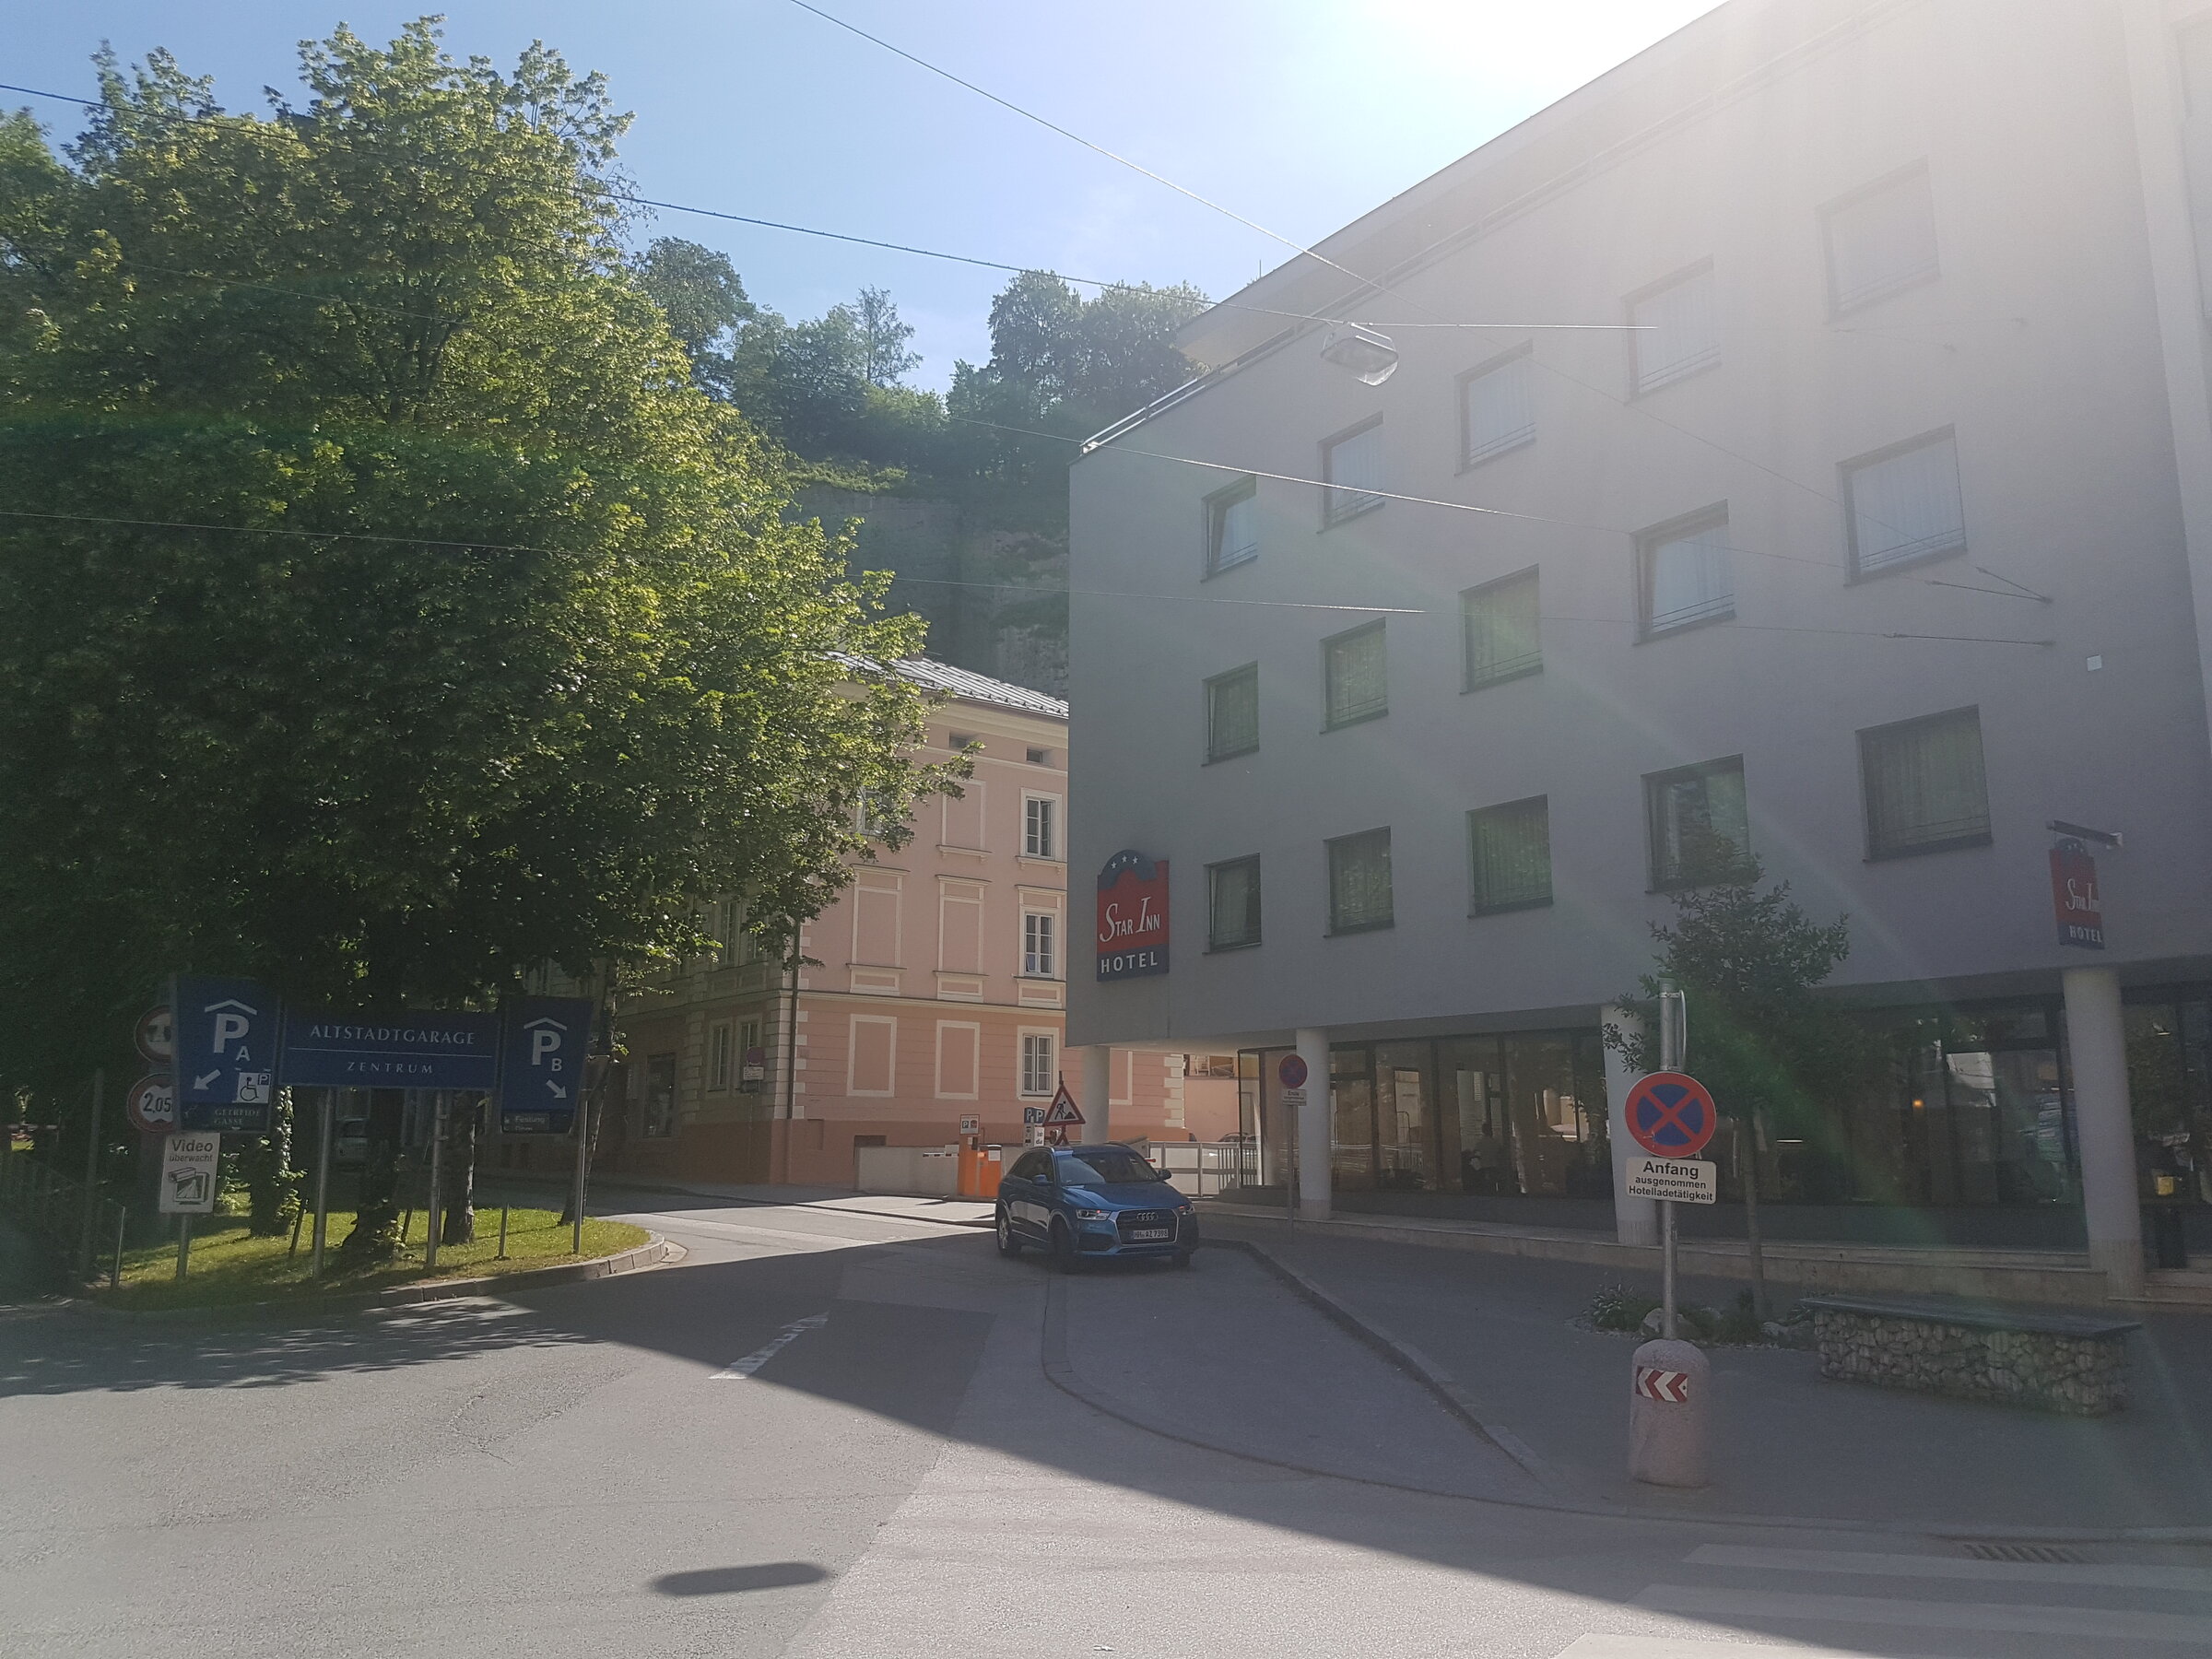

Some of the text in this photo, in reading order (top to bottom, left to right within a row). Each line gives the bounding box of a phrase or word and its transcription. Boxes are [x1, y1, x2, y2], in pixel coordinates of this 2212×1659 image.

[2068, 925, 2102, 943] HOTEL
[1100, 951, 1158, 974] HOTEL
[213, 1013, 250, 1053] P
[310, 1024, 476, 1045] ALTSTADTGARAGE
[235, 1045, 251, 1061] A
[532, 1030, 561, 1065] P
[347, 1061, 433, 1074] ZENTRUM
[551, 1058, 562, 1071] B
[258, 1074, 269, 1085] P
[171, 1138, 214, 1152] Video
[1643, 1161, 1699, 1180] Anfang
[1635, 1176, 1707, 1189] ausgenommen
[1629, 1185, 1713, 1201] Hotelladetätigkeit
